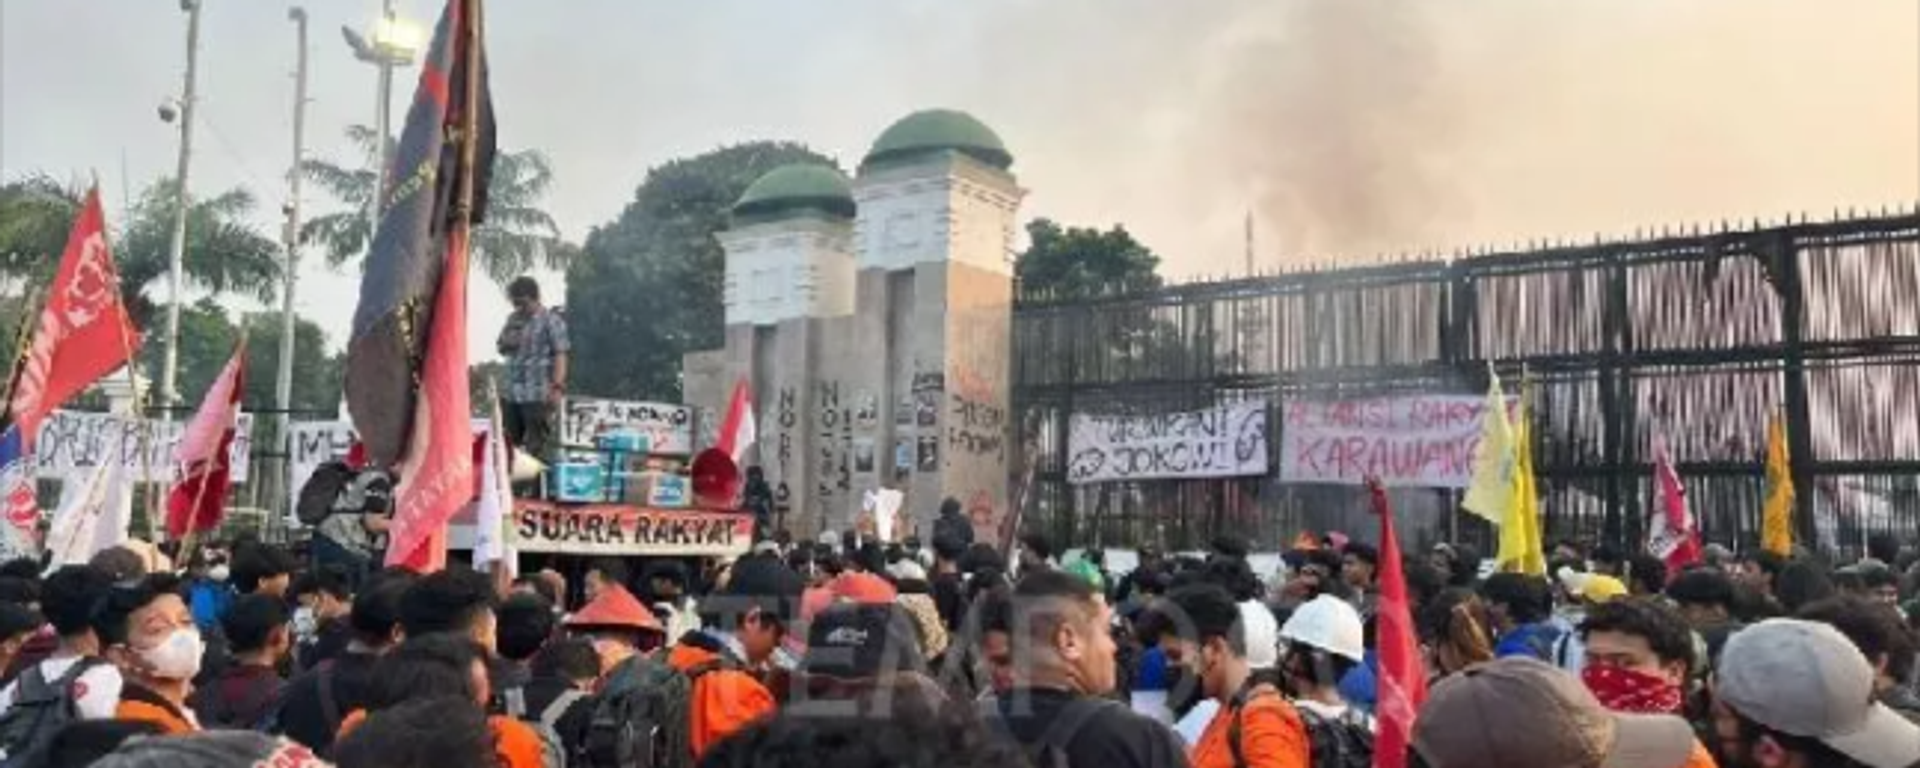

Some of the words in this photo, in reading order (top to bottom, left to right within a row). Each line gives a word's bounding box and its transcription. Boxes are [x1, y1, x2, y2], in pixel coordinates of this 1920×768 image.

[1112, 442, 1231, 476] JOKOWI
[519, 509, 625, 544] SUARA
[634, 515, 737, 545] RAKYAT
